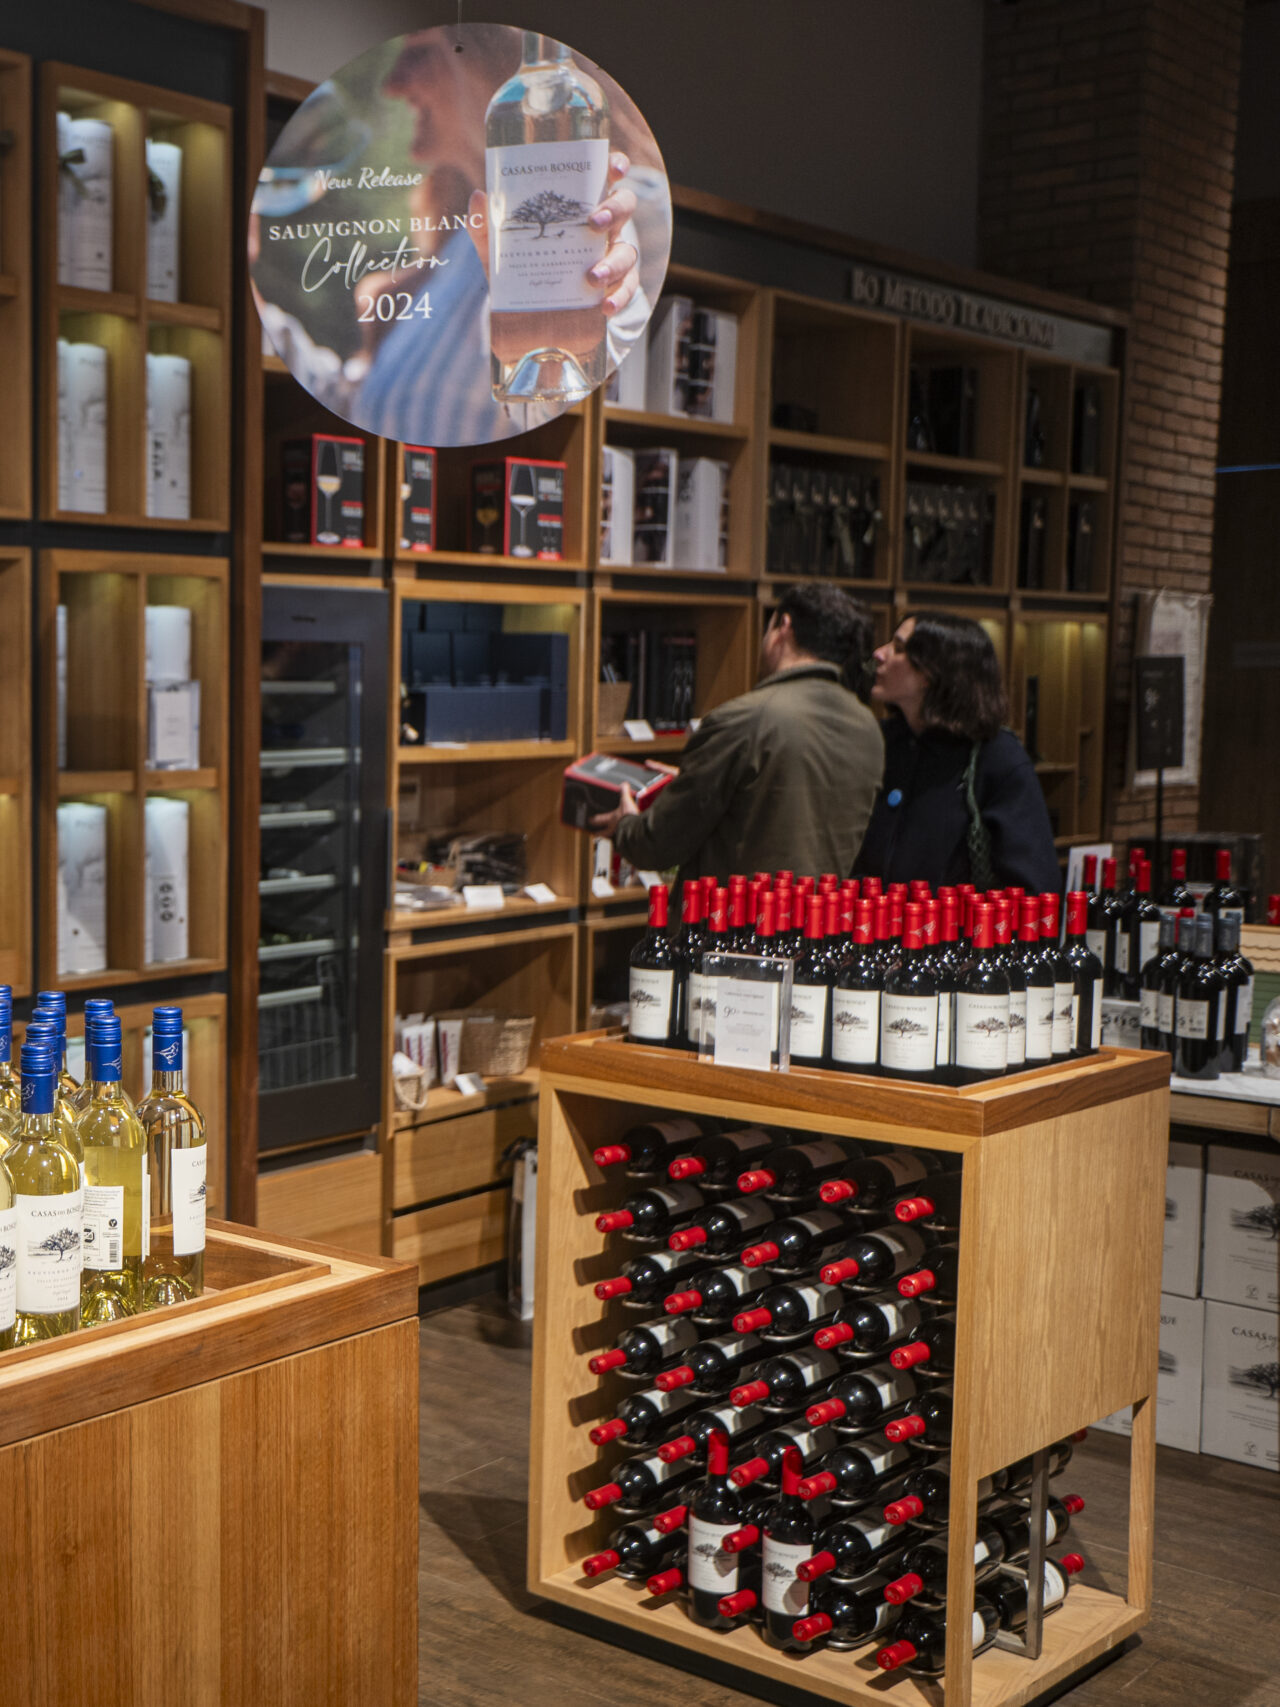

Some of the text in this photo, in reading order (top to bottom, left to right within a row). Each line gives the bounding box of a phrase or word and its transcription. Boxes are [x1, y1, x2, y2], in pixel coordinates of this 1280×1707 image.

[312, 165, 423, 191] New Release
[500, 165, 533, 177] CASAS
[550, 160, 592, 174] BOSQUE
[268, 213, 484, 241] SAUVIGNON BLANC
[300, 235, 450, 293] Collection
[357, 291, 434, 323] 2024
[31, 1208, 57, 1218] CASAS
[1231, 1326, 1268, 1341] CASAS
